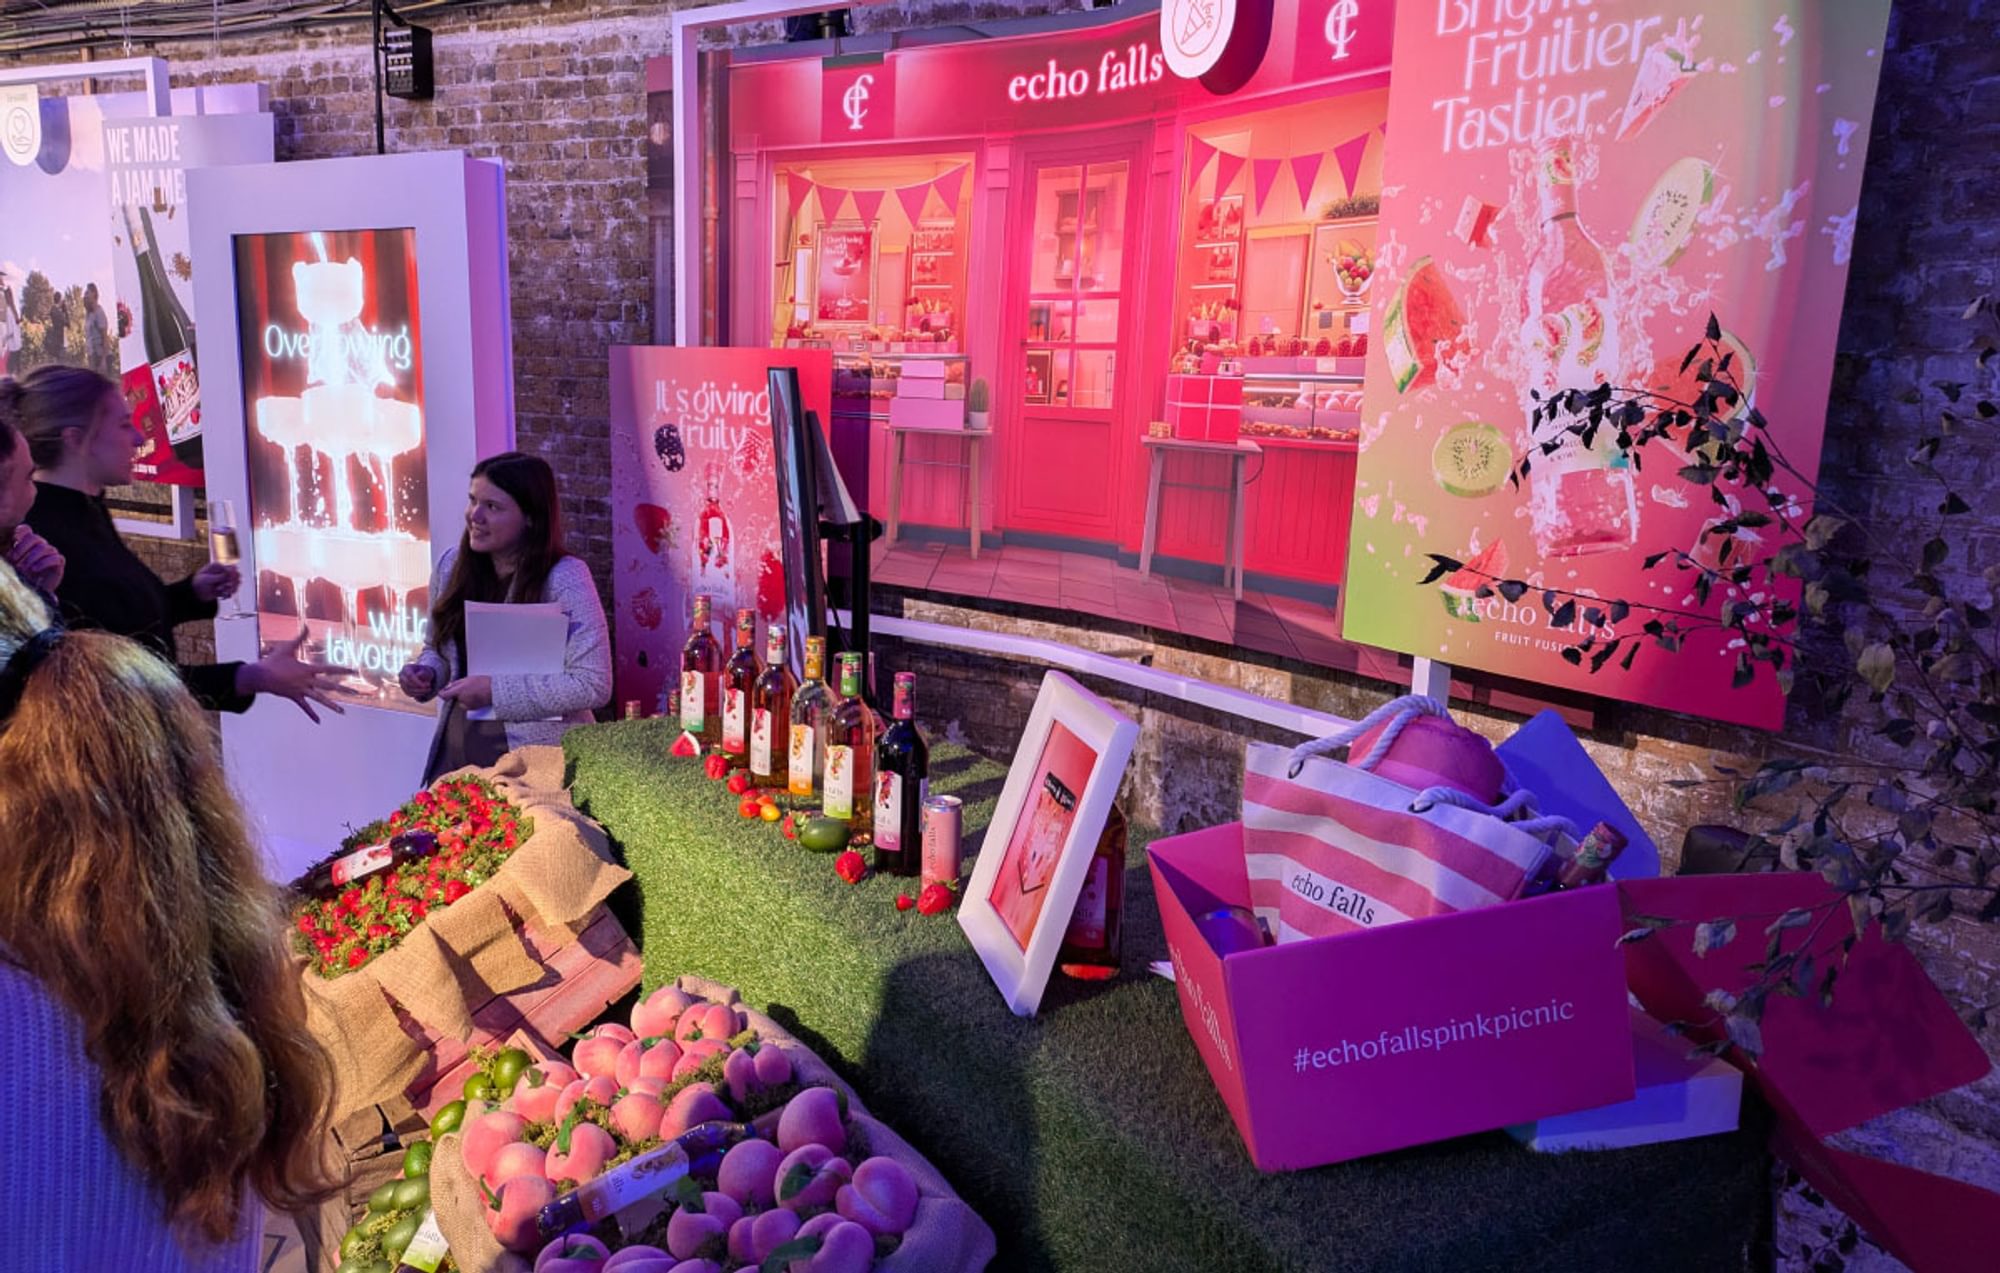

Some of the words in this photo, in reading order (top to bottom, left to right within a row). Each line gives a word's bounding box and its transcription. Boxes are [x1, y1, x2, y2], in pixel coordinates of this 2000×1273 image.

[1008, 58, 1089, 101] echo
[1097, 43, 1163, 93] falls
[1464, 11, 1663, 91] Fruitier
[107, 127, 131, 163] WE
[133, 124, 181, 162] MADE
[111, 170, 124, 206] A
[125, 169, 155, 205] JAM
[656, 379, 689, 414] It's
[692, 381, 771, 426] giving
[678, 413, 747, 462] fruity
[368, 606, 428, 643] with
[1495, 631, 1530, 648] FRUIT
[1291, 872, 1324, 901] echo
[1327, 886, 1374, 925] falls
[1293, 998, 1575, 1074] #echofallspinkpicnic
